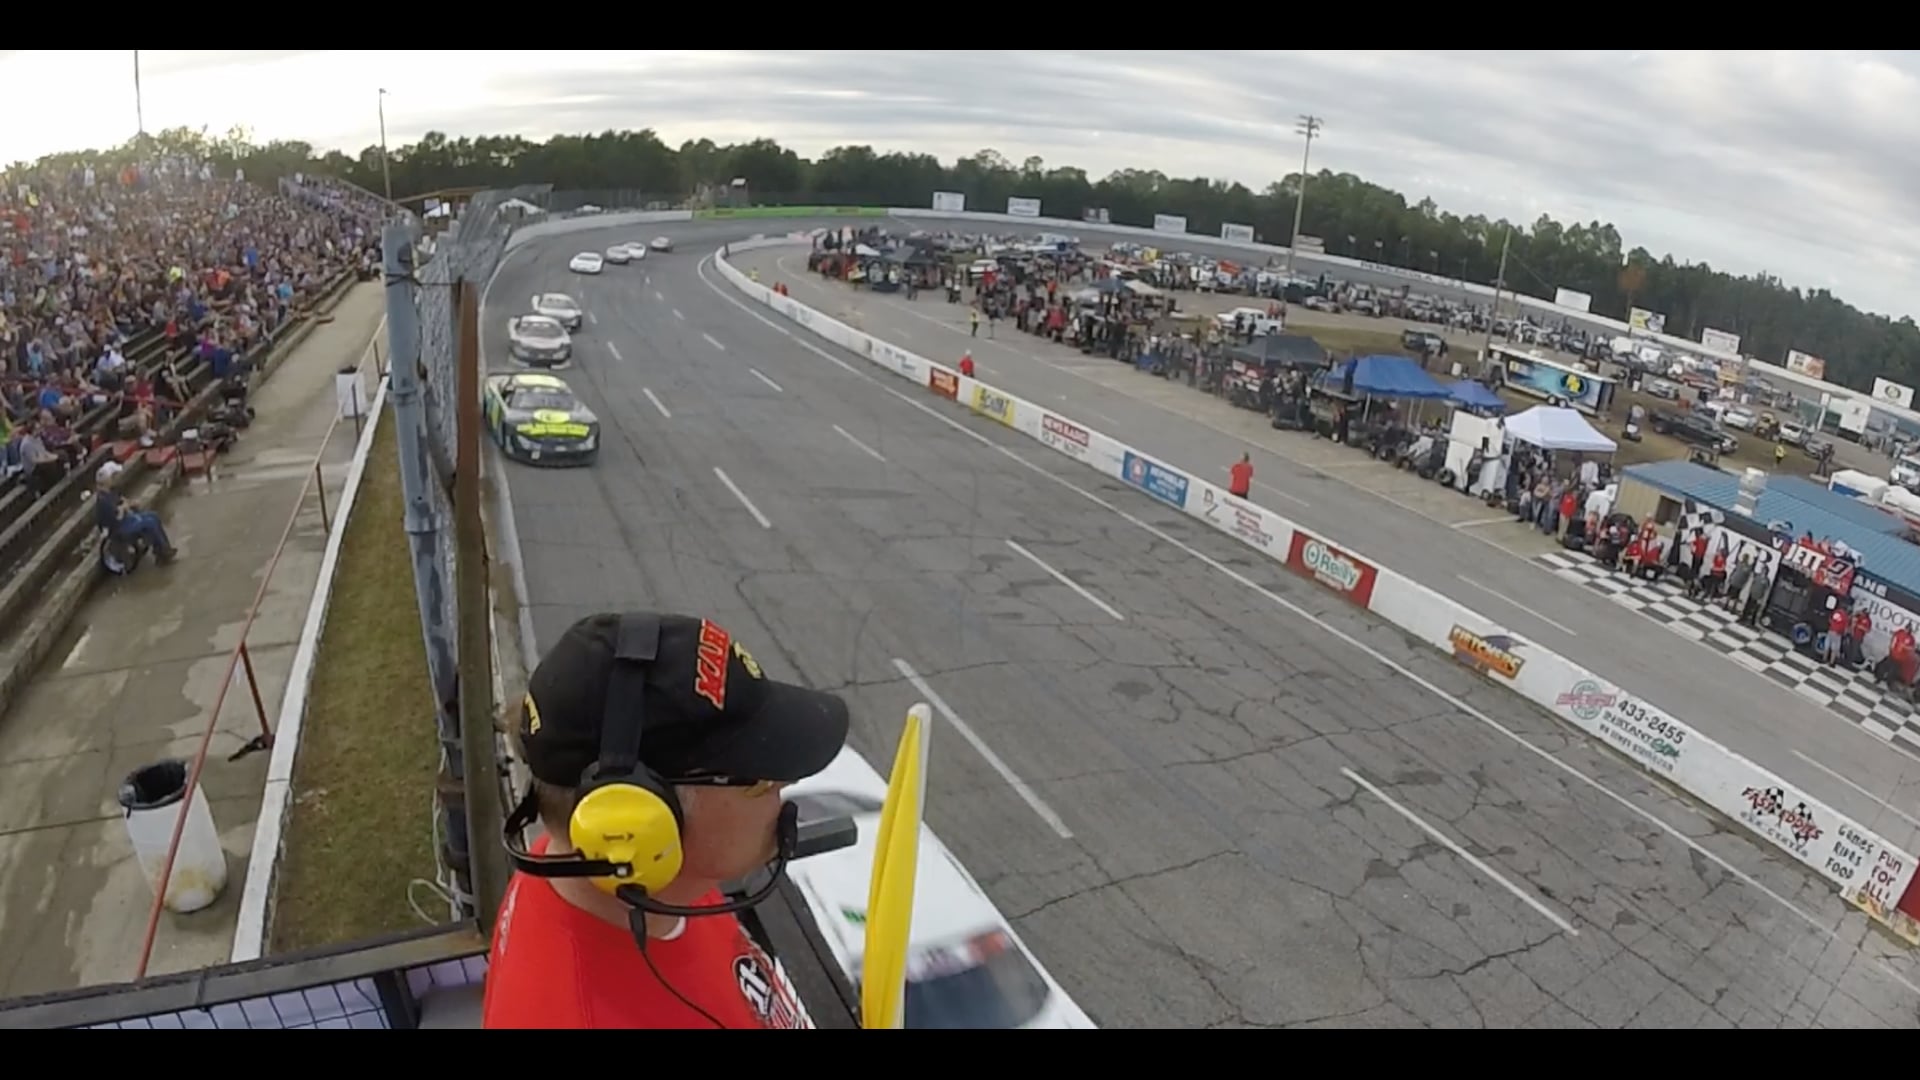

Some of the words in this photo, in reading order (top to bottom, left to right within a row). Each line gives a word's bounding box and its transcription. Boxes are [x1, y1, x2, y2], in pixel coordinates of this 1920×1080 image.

[1785, 543, 1826, 572] JETT
[1853, 574, 1889, 597] ANE
[1617, 699, 1687, 745] 433-2455
[1741, 786, 1774, 811] FAST
